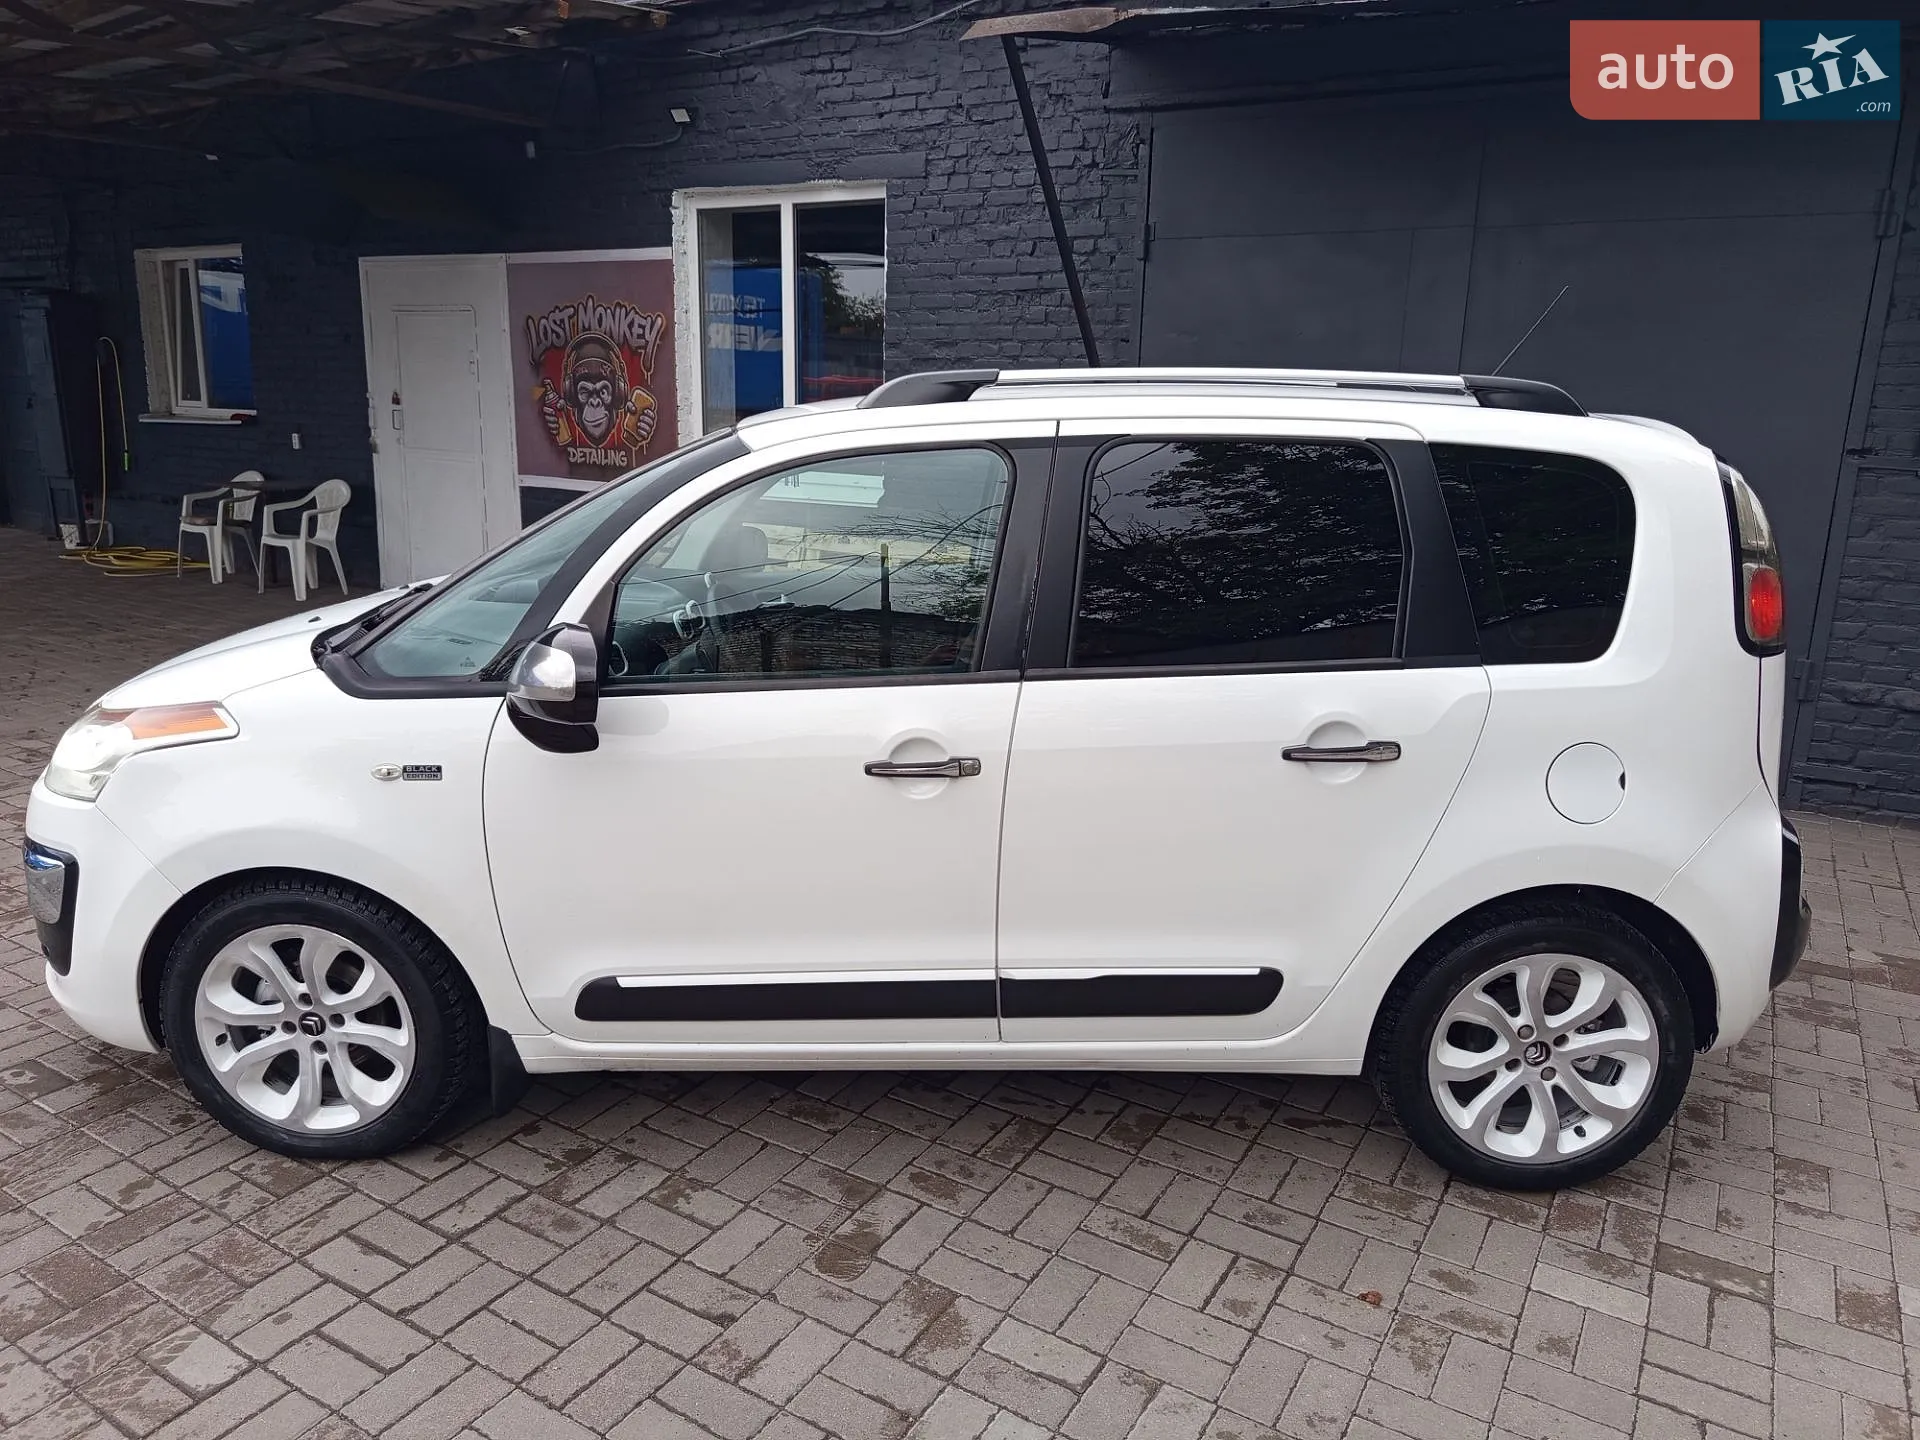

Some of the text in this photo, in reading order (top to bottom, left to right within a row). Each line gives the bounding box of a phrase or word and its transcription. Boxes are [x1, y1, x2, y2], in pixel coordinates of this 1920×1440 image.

[526, 305, 576, 363] LOST
[577, 294, 663, 373] MONKEY
[567, 446, 628, 467] DETAILING
